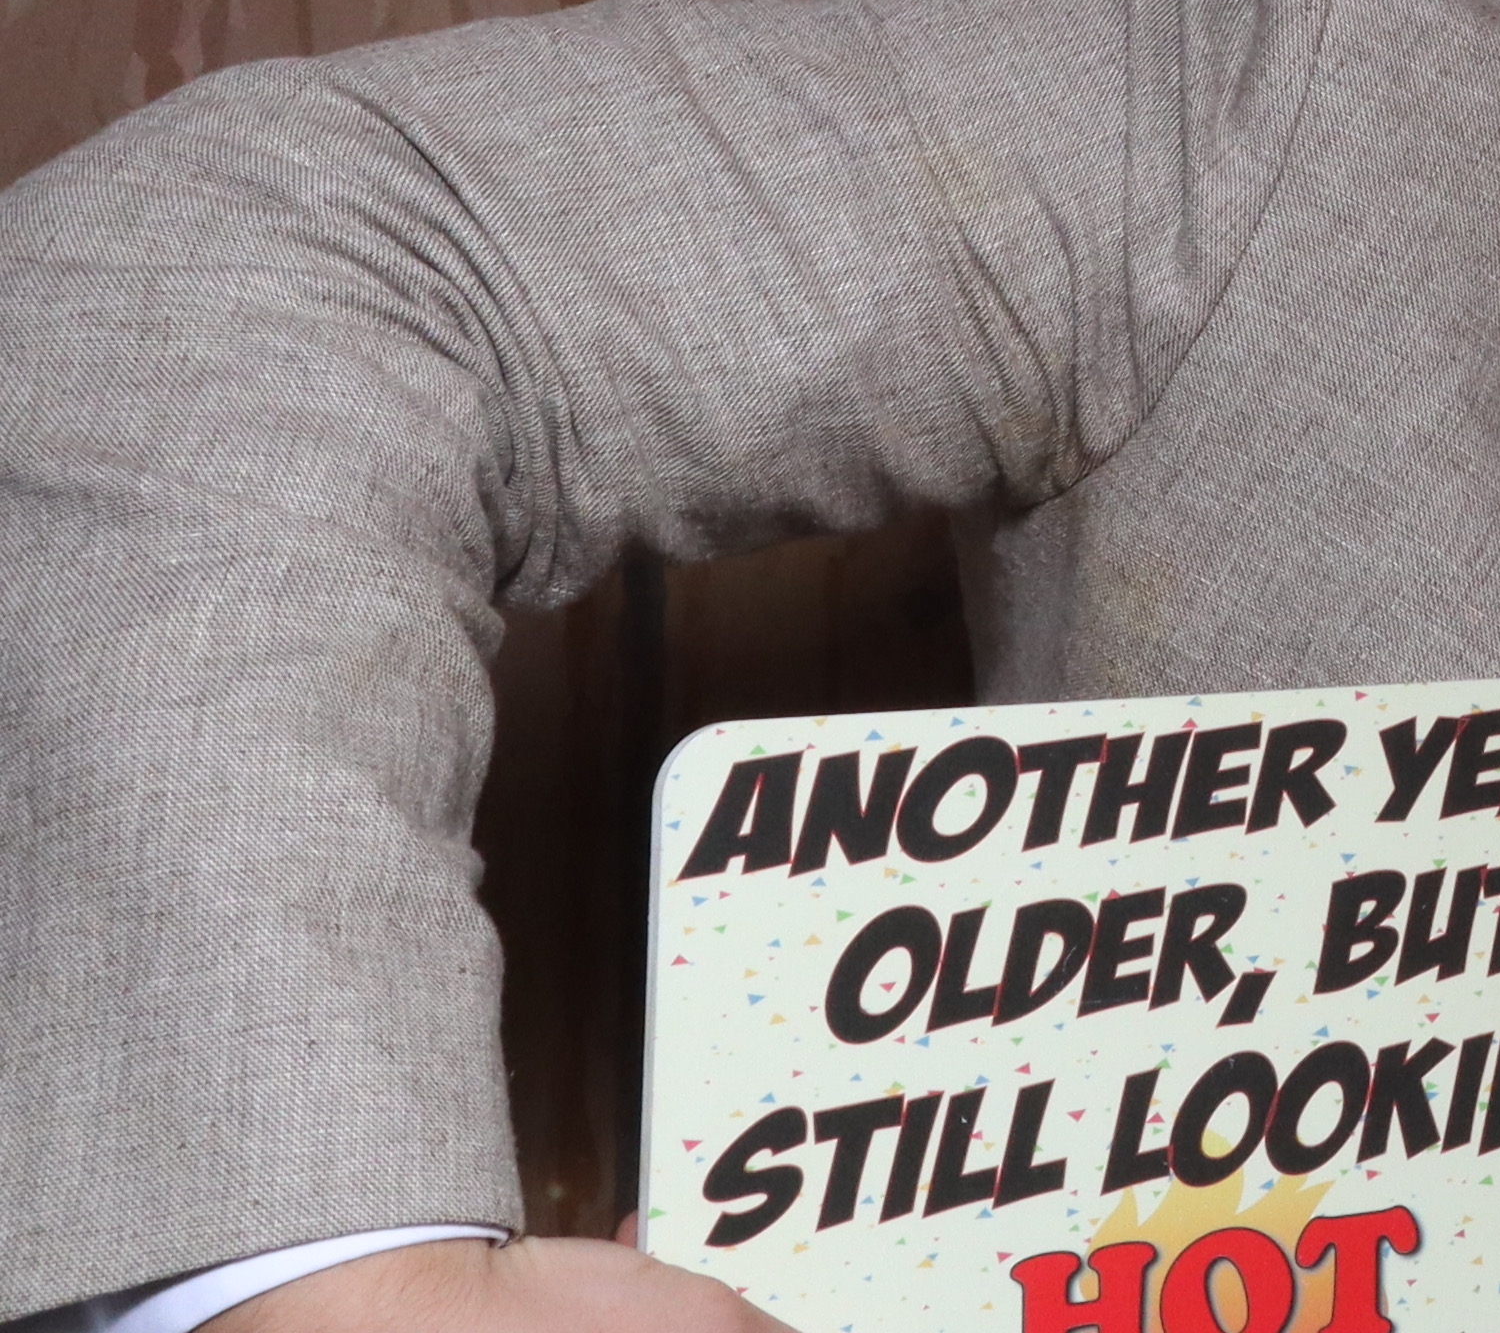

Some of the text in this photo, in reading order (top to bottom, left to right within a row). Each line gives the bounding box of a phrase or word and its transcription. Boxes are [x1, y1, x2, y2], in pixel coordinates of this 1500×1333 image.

[677, 718, 1348, 882] ANOTHER
[824, 882, 1274, 1045] OLDER,
[702, 1081, 1067, 1249] STILL
[1009, 1205, 1421, 1333] HOT
